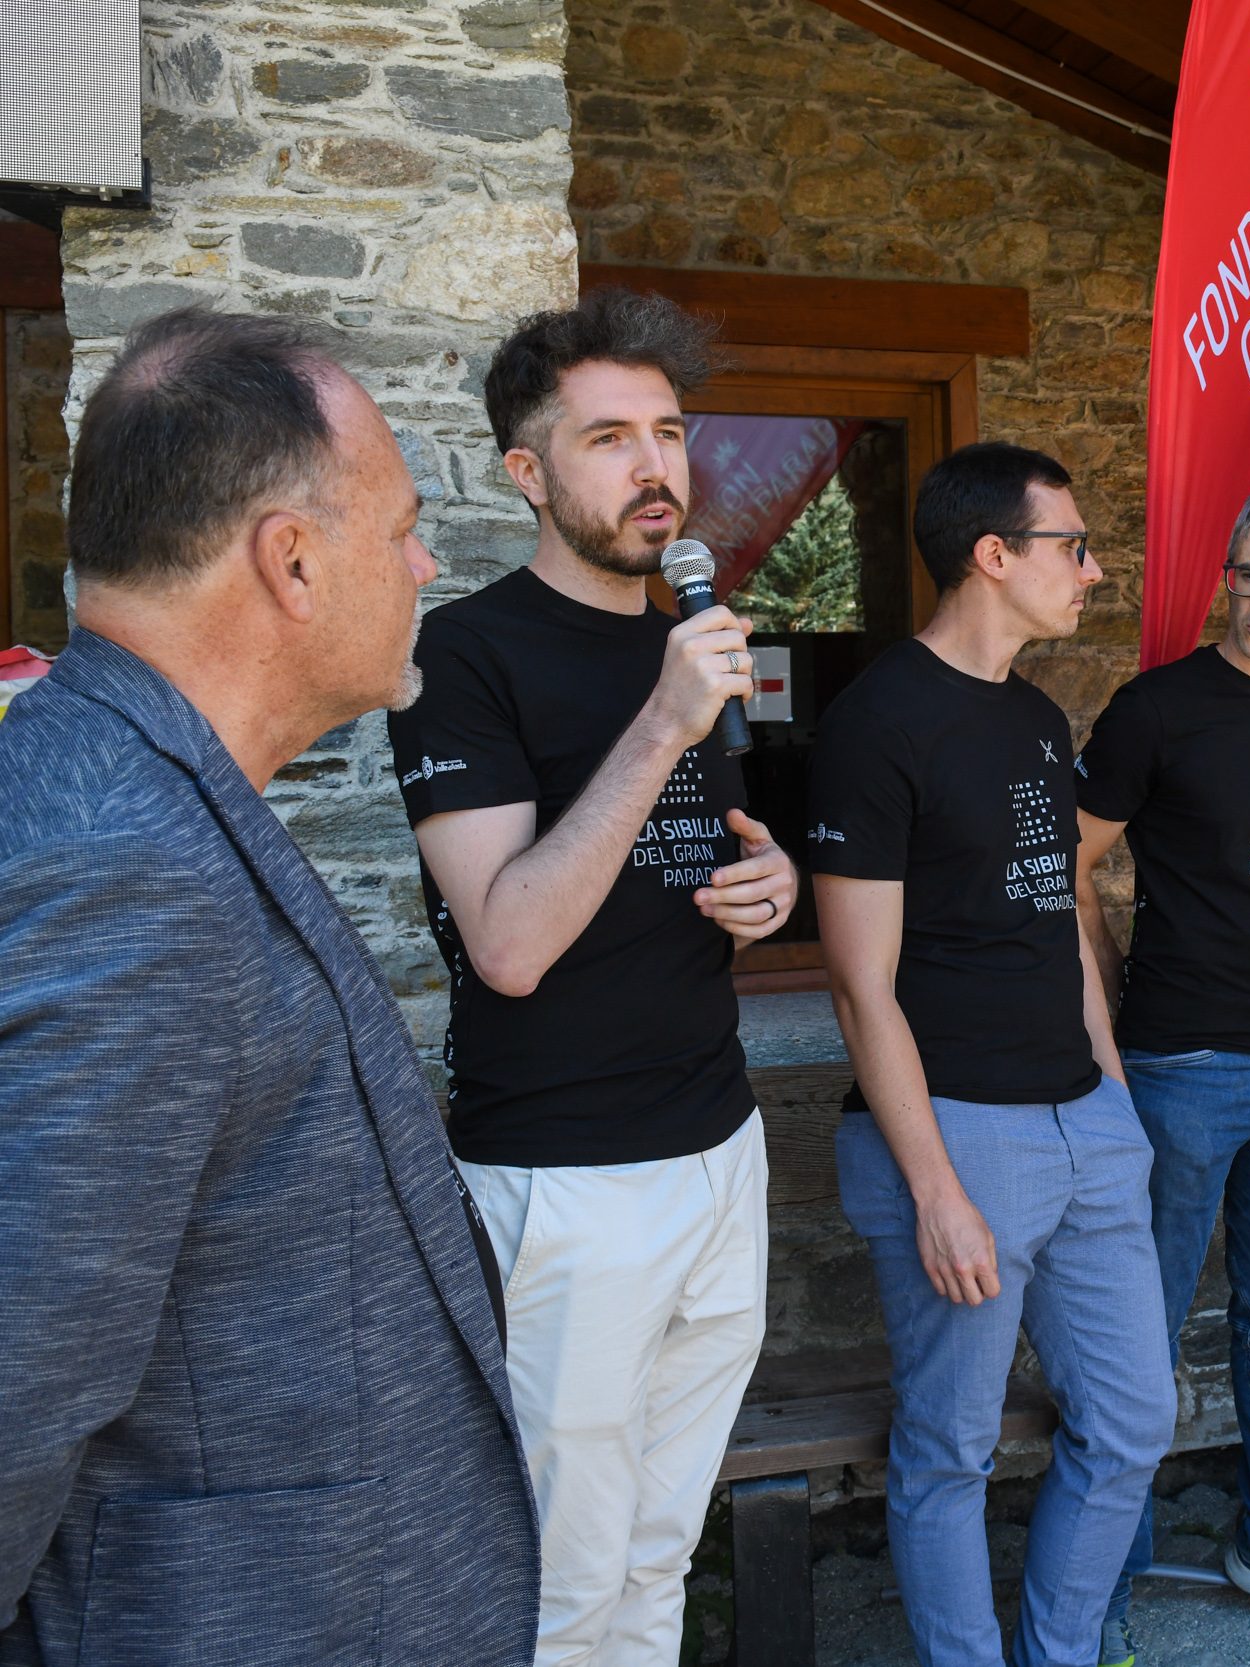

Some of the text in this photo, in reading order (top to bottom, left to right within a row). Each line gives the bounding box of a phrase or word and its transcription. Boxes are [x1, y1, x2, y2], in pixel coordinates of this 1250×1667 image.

[661, 818, 725, 840] SIBILLA
[633, 844, 715, 867] DEL GRAN
[1006, 861, 1025, 880] LA
[1005, 881, 1037, 900] DEL
